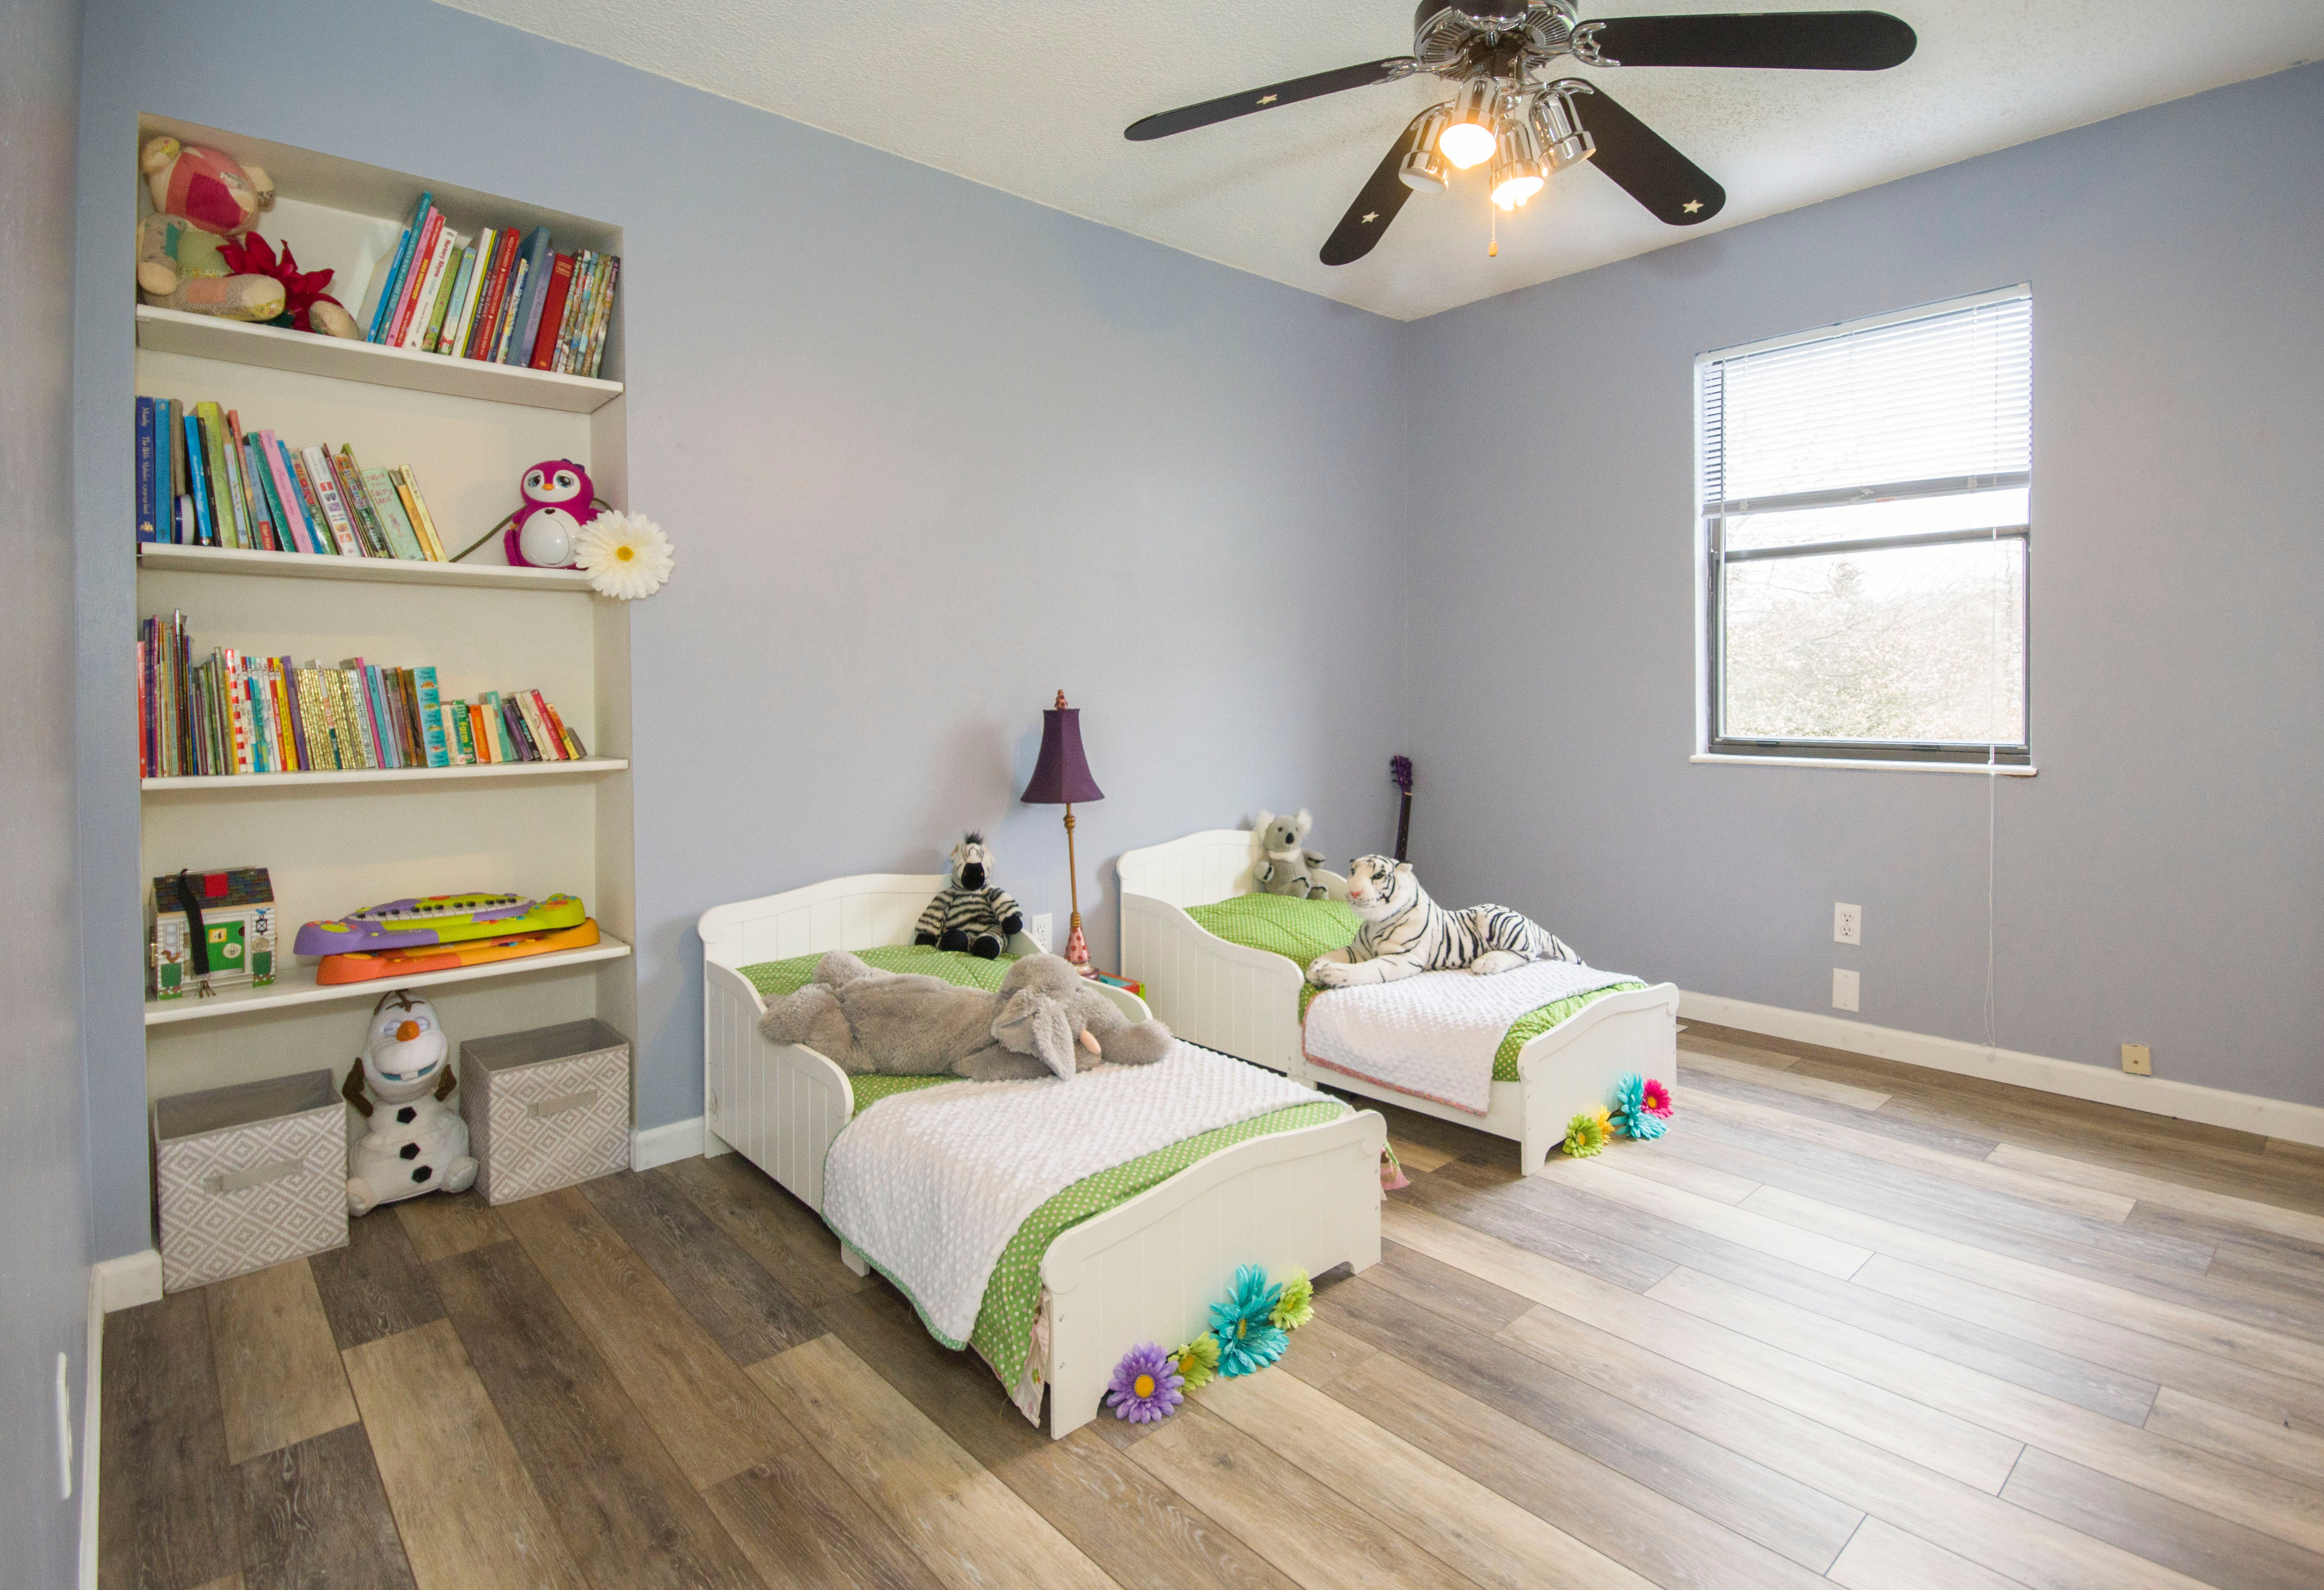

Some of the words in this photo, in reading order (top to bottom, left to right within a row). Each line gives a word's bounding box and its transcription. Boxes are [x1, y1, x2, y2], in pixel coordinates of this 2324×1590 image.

[406, 237, 416, 258] GOLDEN
[439, 238, 451, 260] Nursery
[433, 260, 445, 277] Rhyme
[481, 279, 490, 297] Zombie
[487, 279, 495, 296] Zombie
[343, 468, 355, 487] SEEK
[352, 490, 364, 509] SLIDE
[322, 697, 331, 710] HOP
[458, 721, 471, 743] Farm
